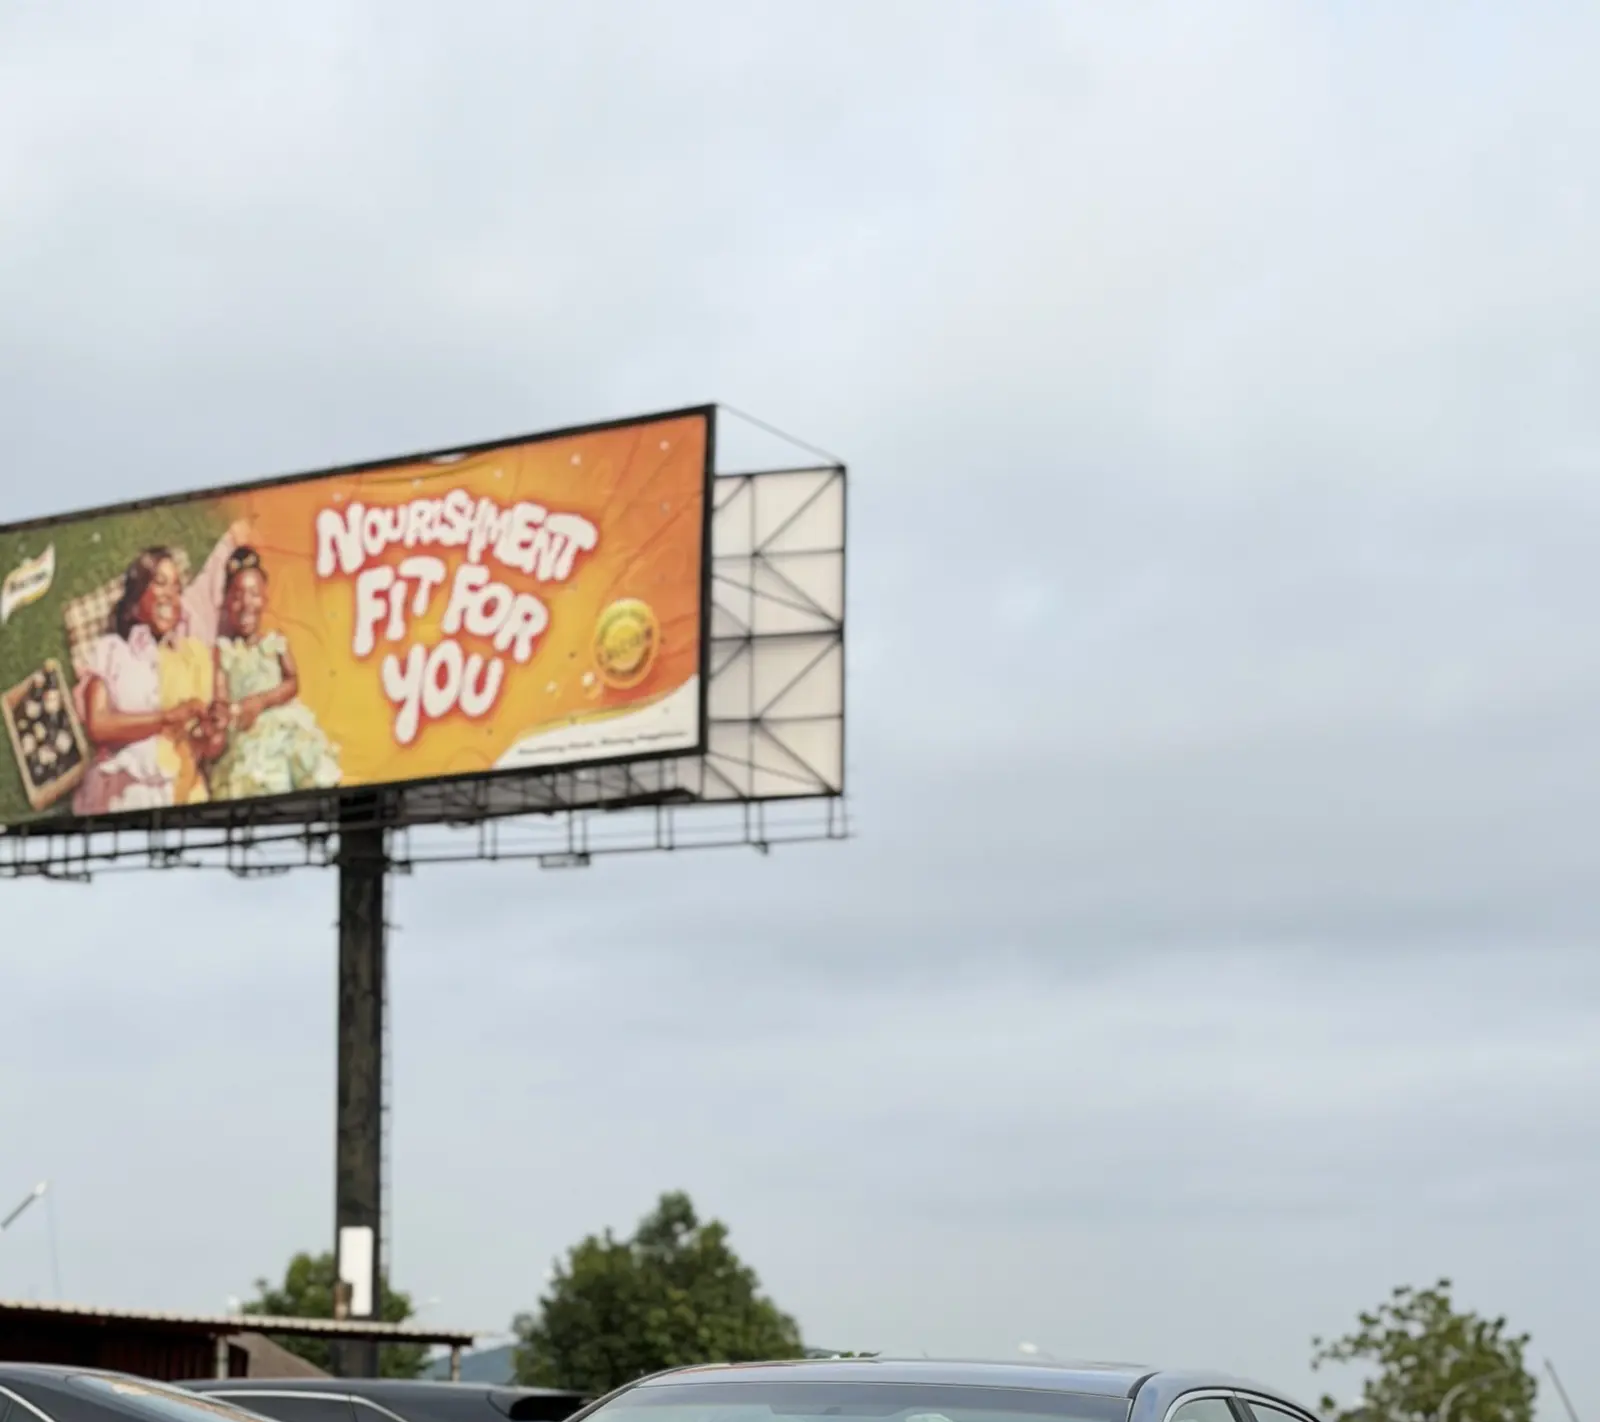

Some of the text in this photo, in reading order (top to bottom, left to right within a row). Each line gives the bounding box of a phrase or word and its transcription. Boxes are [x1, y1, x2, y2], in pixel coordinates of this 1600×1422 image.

[317, 489, 598, 581] NOURISHMENT
[353, 556, 446, 656] FIT
[442, 564, 548, 662] FOR
[382, 639, 504, 743] YOU
